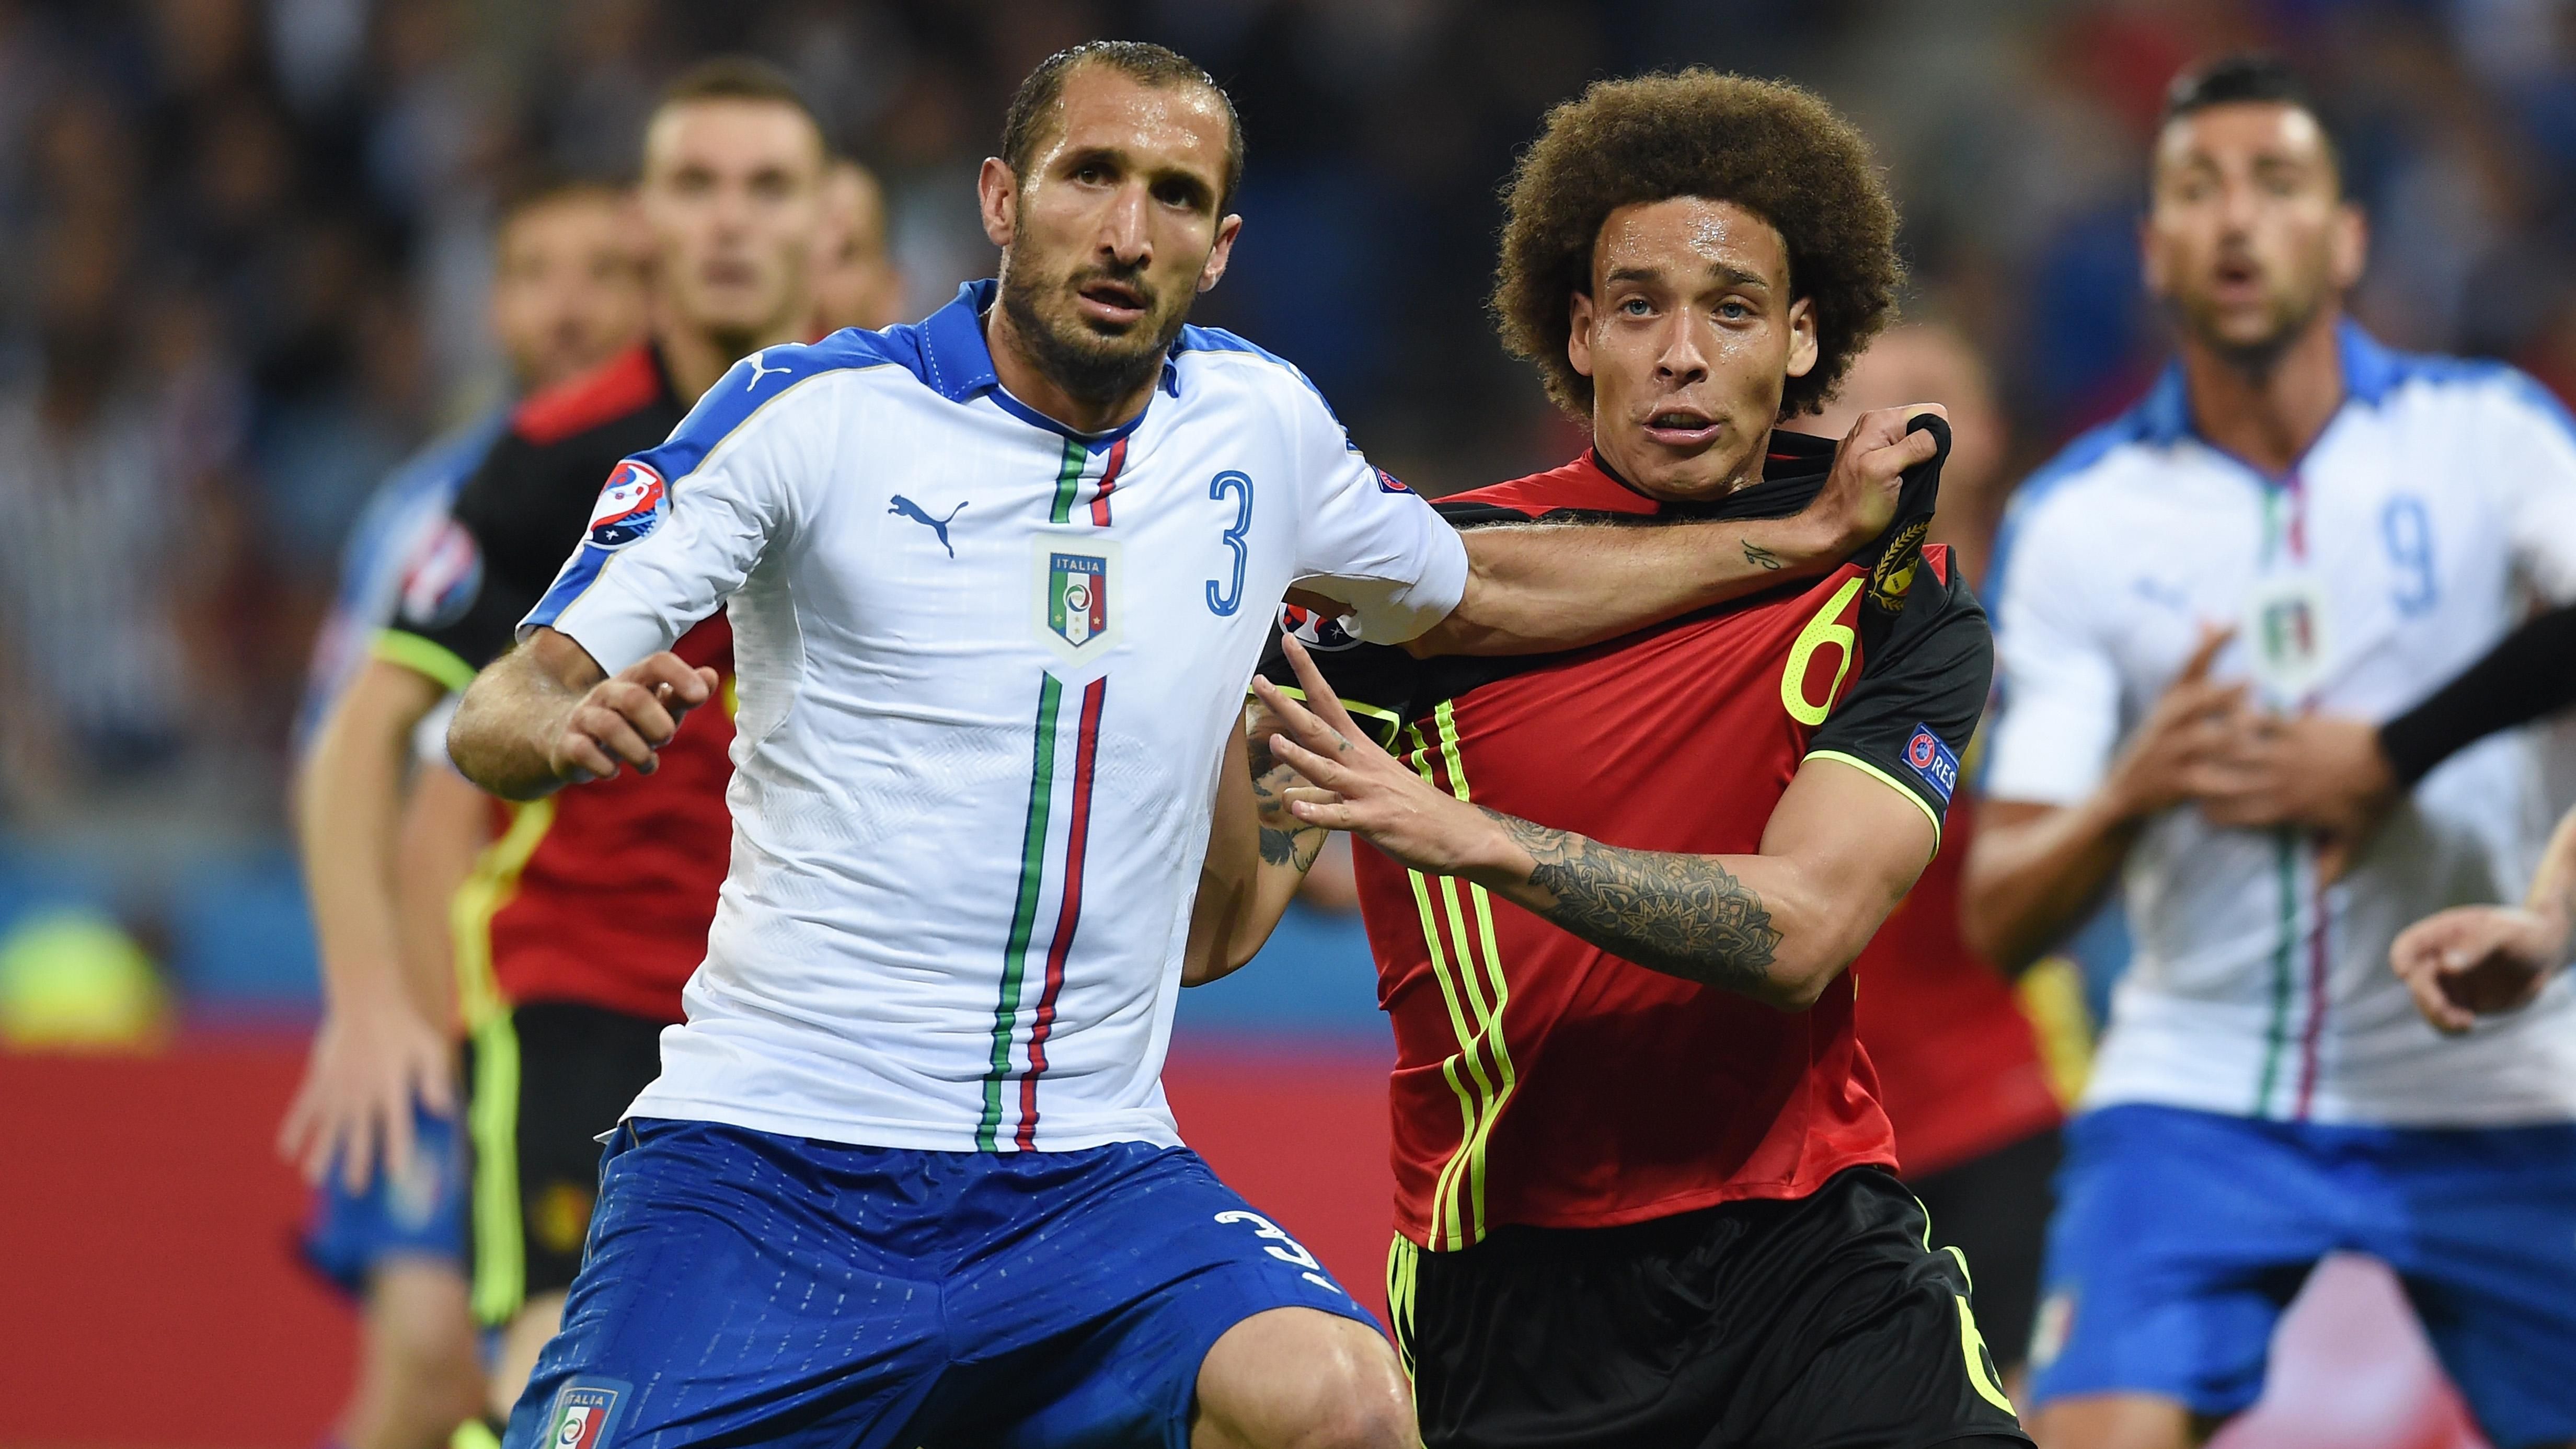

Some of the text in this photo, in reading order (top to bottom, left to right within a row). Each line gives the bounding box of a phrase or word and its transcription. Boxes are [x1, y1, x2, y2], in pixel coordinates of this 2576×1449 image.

[1056, 558, 1100, 572] ITALIA
[1206, 470, 1254, 617] 3
[2380, 492, 2439, 619] 9
[1780, 577, 1866, 726] 6
[1931, 755, 1955, 790] RES
[1214, 1211, 1320, 1271] 3
[565, 1394, 604, 1405] ITALIA
